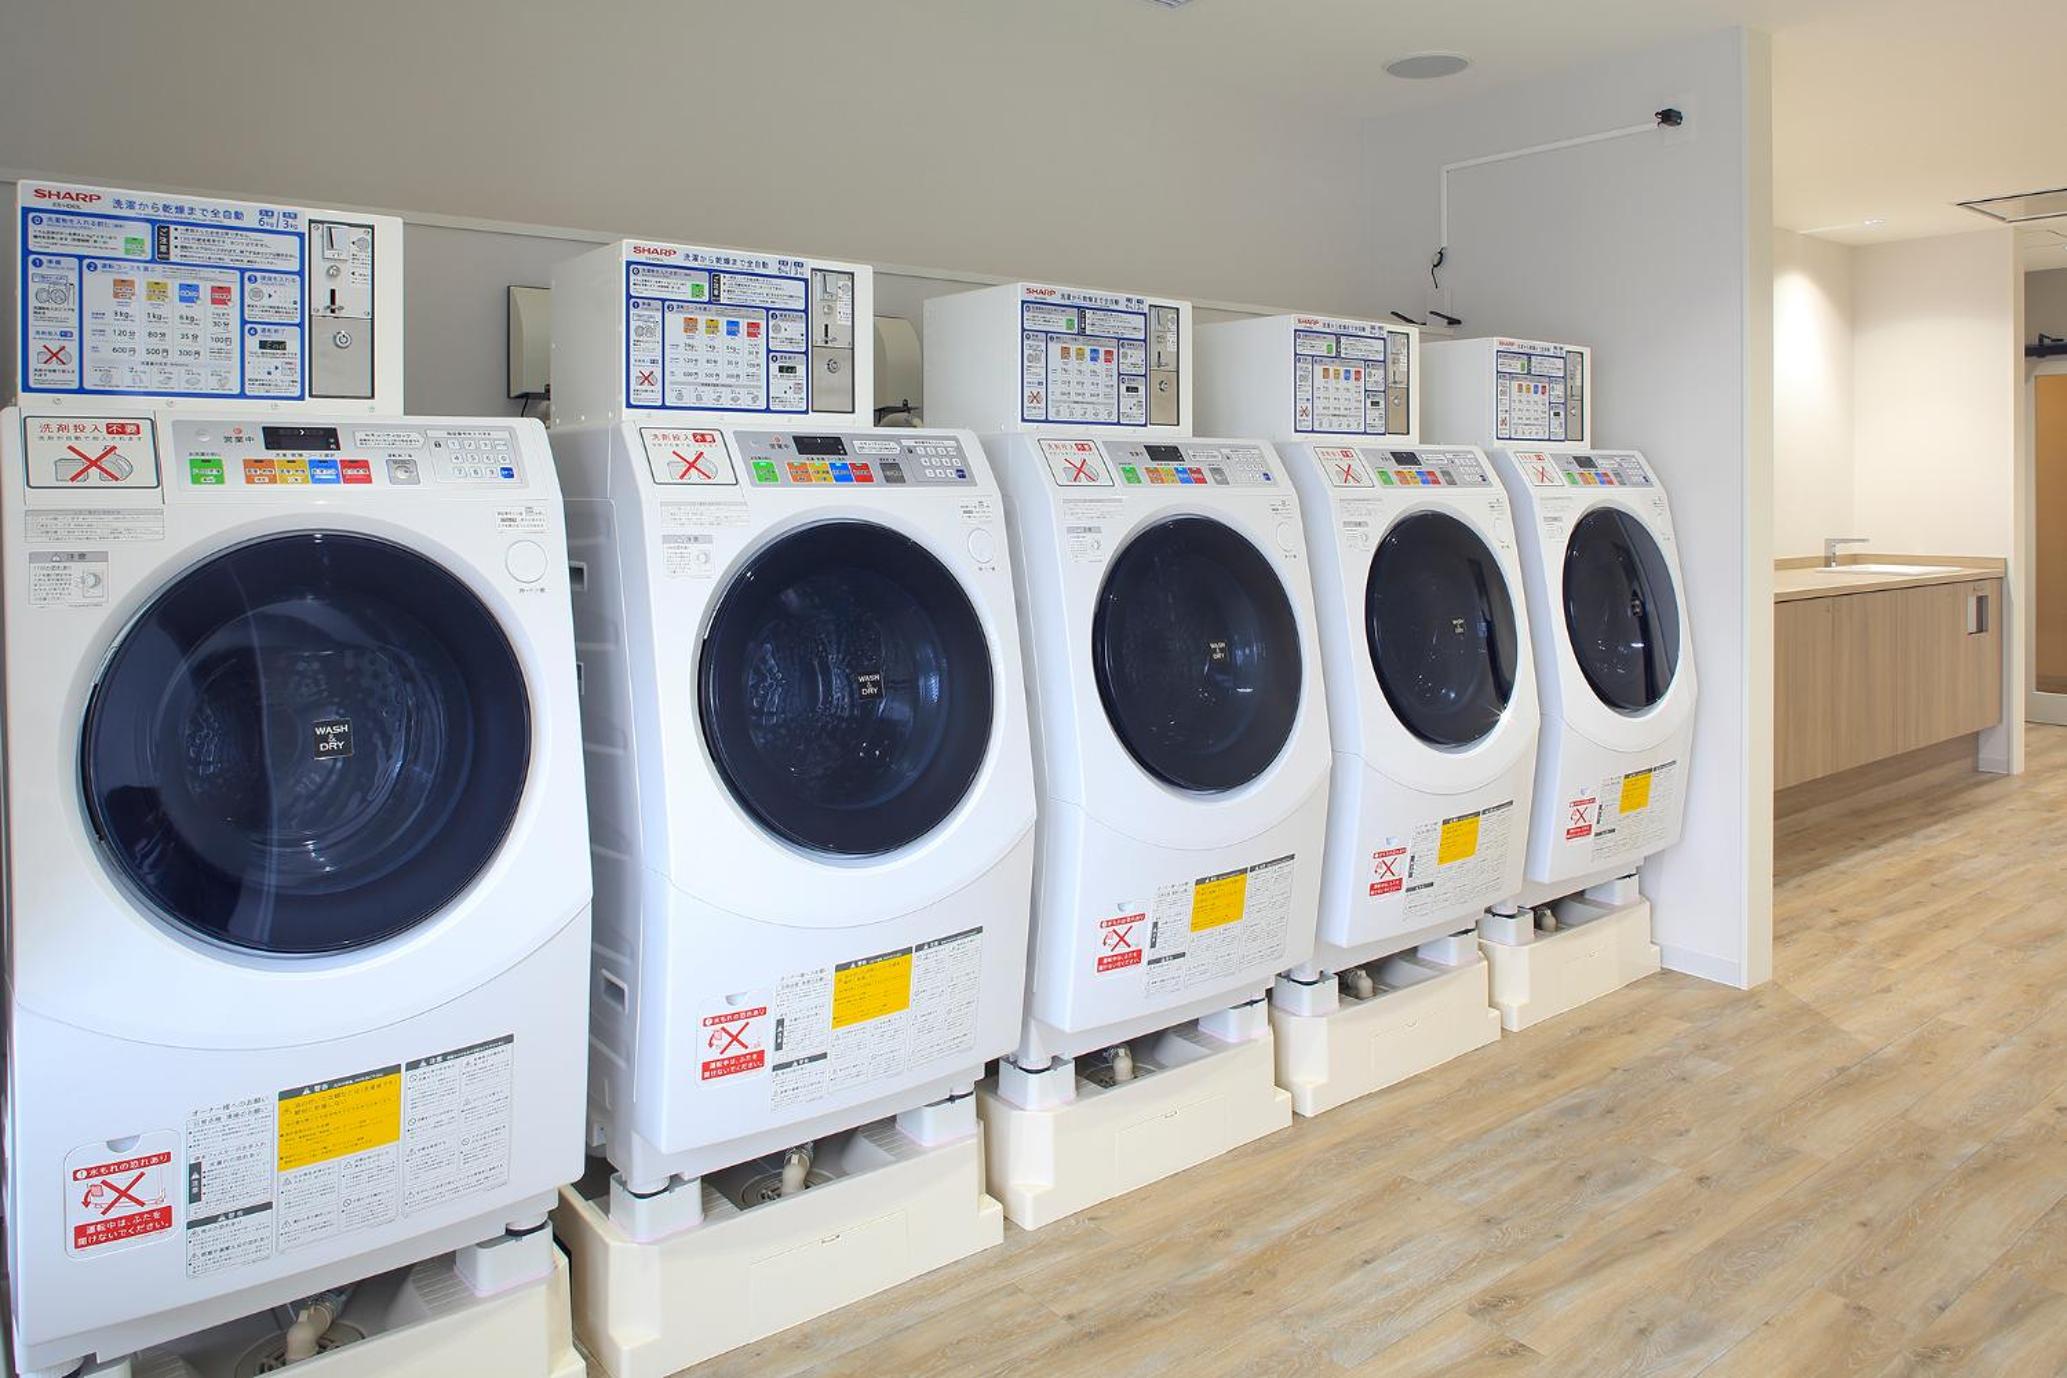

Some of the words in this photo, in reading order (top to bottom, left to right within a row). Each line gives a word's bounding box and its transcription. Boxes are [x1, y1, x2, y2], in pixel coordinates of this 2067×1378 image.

[33, 188, 102, 203] SHARP
[632, 245, 677, 257] SHARP
[1025, 287, 1056, 297] SHARP
[39, 422, 103, 434] 洗剤投入
[858, 674, 880, 683] WASH
[861, 687, 879, 696] DRY
[315, 724, 348, 735] WASH
[328, 734, 337, 742] &
[320, 741, 345, 752] DRY
[88, 1153, 169, 1177] 水もれの恐れあり
[86, 1211, 161, 1234] 運転中は、ふたを
[77, 1221, 170, 1247] 開けないでください。
